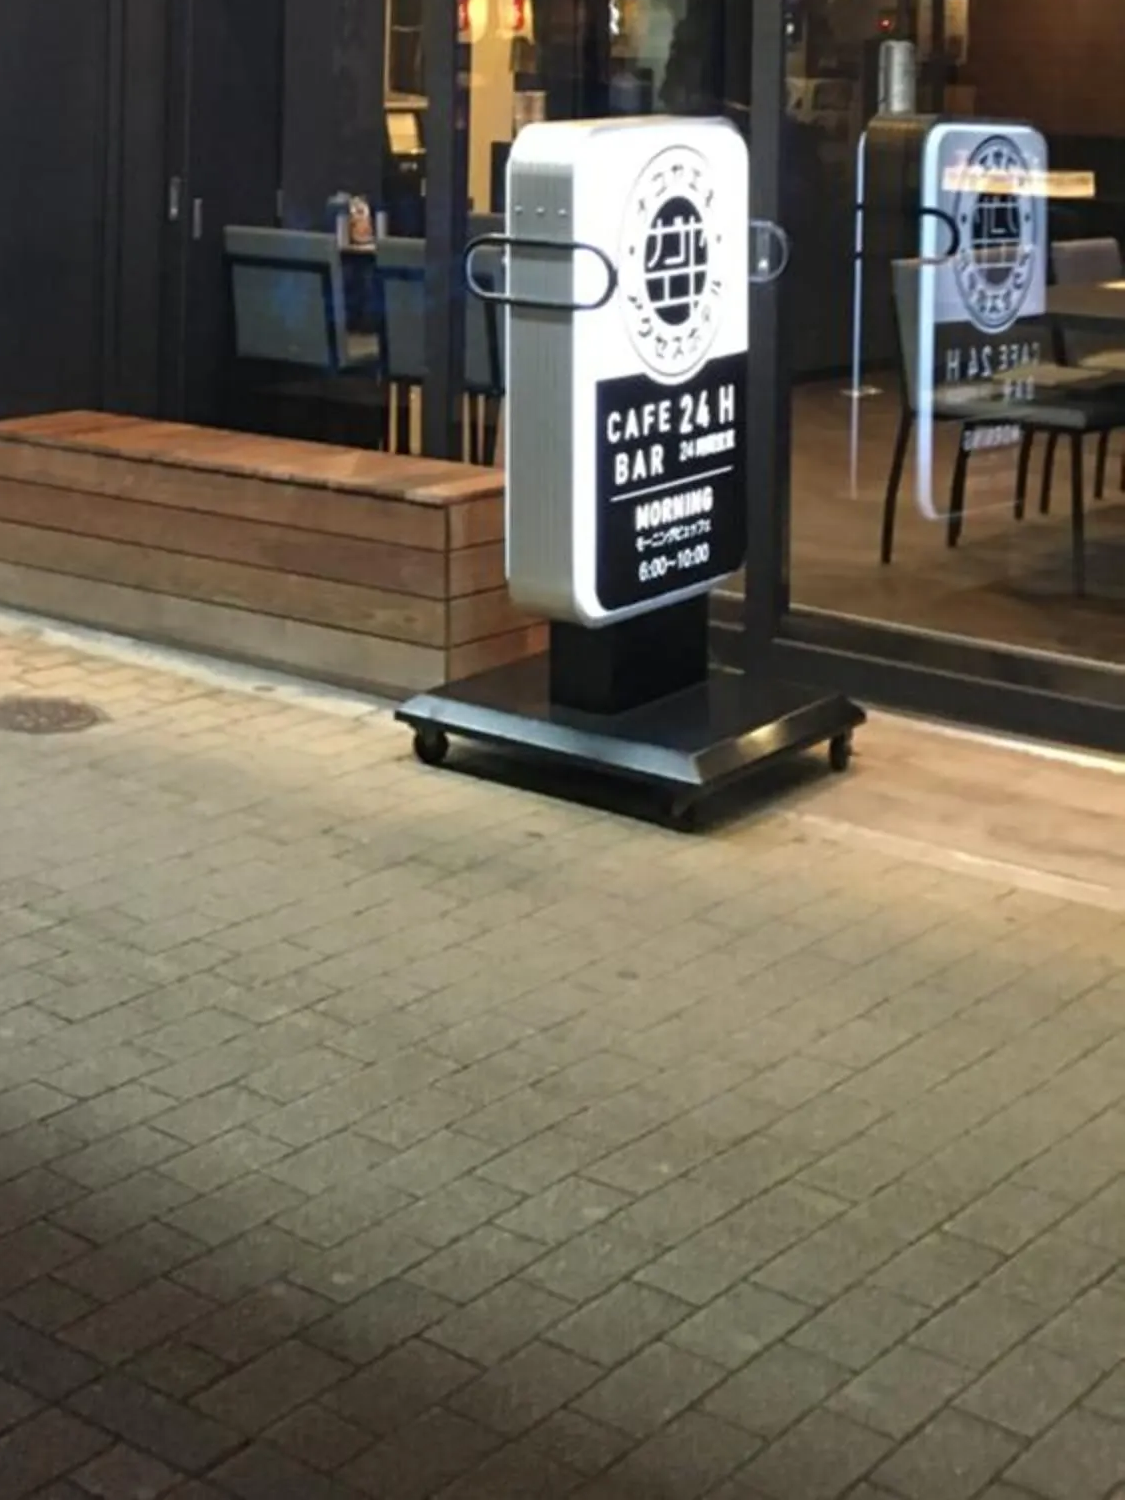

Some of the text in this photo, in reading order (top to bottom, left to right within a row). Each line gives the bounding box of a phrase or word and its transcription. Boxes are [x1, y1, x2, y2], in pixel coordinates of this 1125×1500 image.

[606, 383, 735, 443] CAFE 24 H
[614, 443, 665, 486] BAR
[635, 485, 714, 532] MORNING
